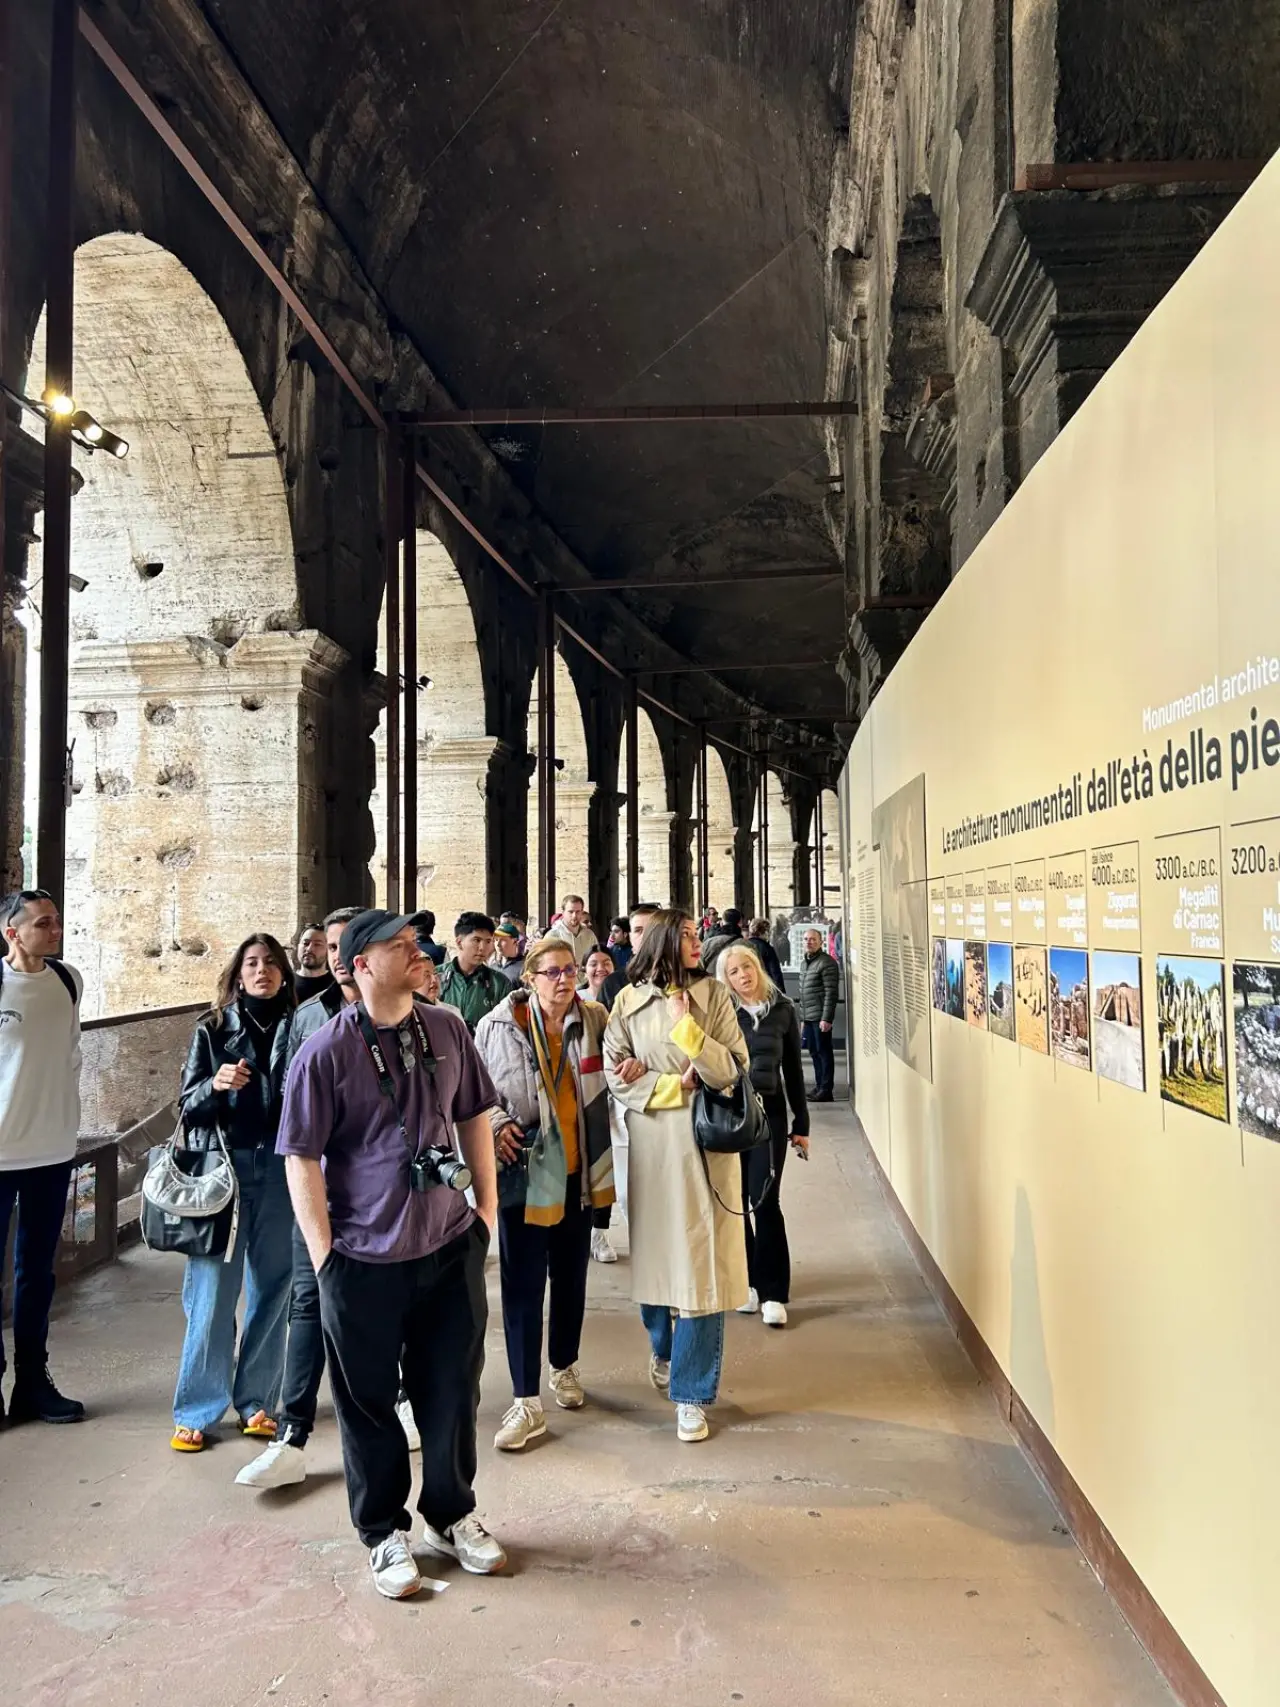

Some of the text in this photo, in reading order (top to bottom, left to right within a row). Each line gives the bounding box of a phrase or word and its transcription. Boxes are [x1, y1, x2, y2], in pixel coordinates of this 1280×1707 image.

[1142, 656, 1280, 733] Monumental archite
[942, 706, 1280, 854] Le architetture monumentali dall'età della pie
[1155, 856, 1181, 880] 3300
[1231, 845, 1266, 875] 3200
[370, 1044, 386, 1073] Canon
